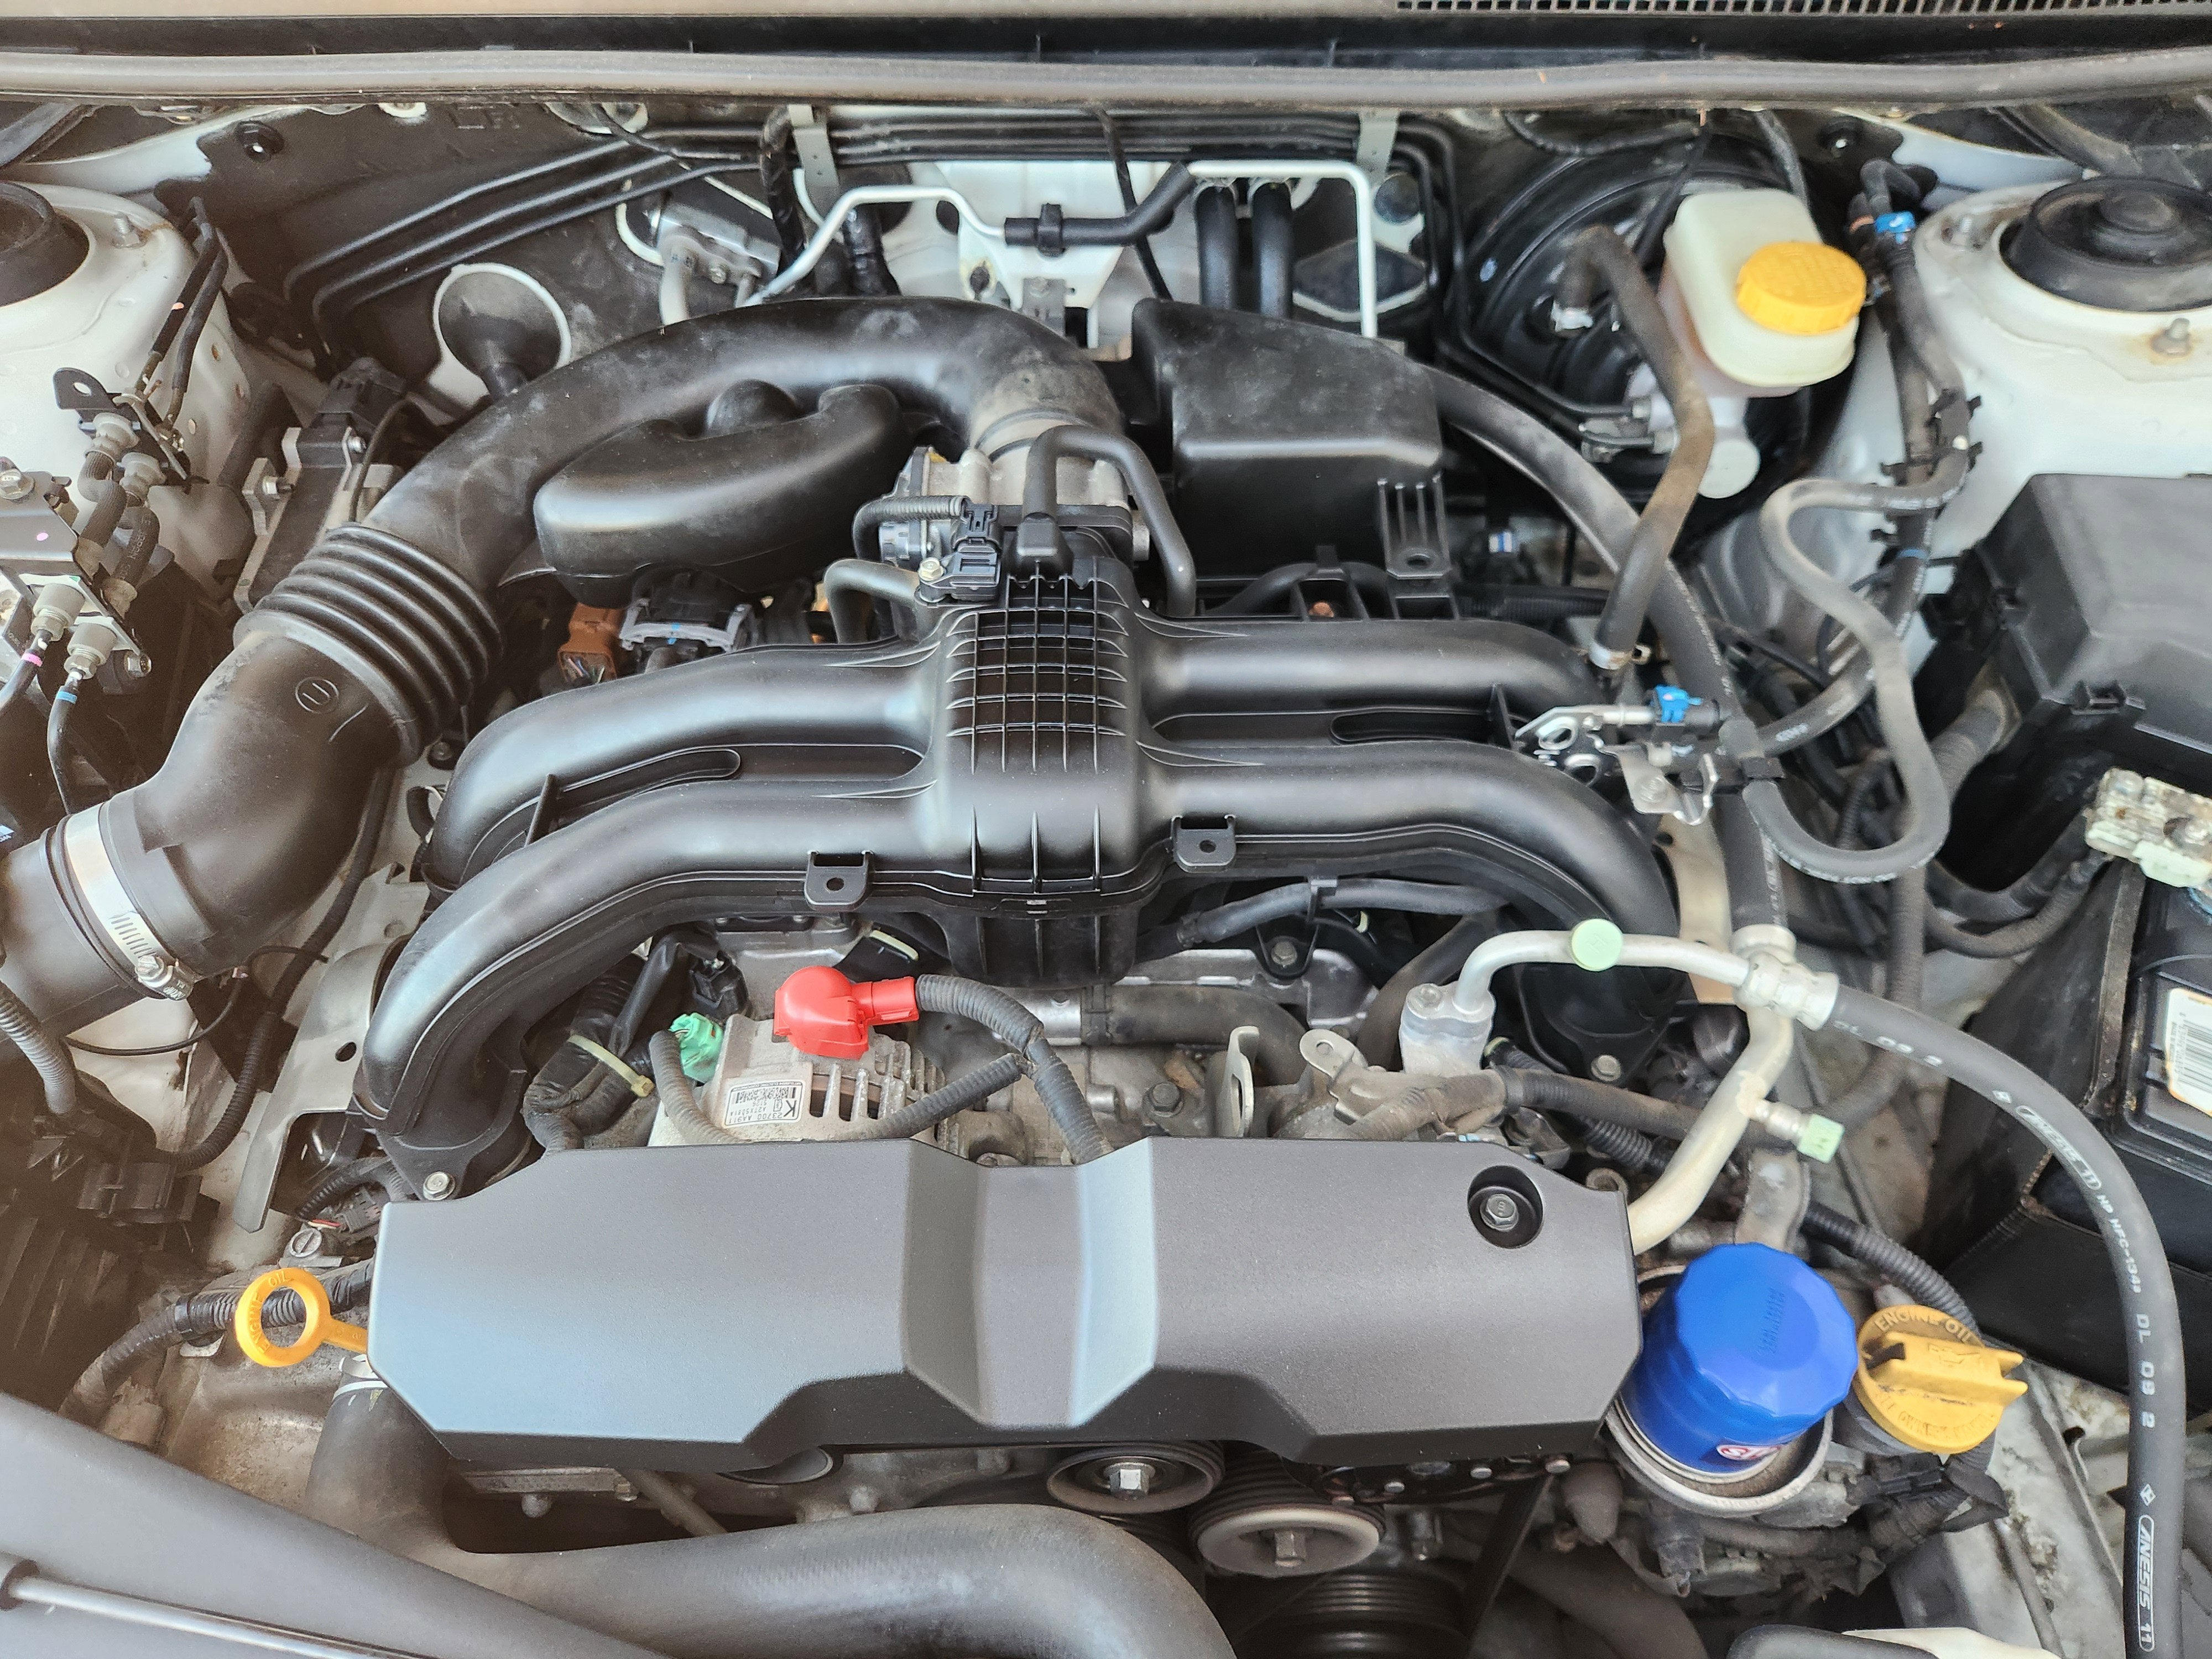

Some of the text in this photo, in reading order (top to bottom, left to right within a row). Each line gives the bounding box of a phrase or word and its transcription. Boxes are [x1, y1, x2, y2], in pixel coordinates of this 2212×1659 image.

[783, 1100, 797, 1117] K
[248, 1270, 289, 1354] ENGINE OIL
[1944, 1318, 1973, 1344] OIL
[2139, 1523, 2152, 1644] ANESIS 11
